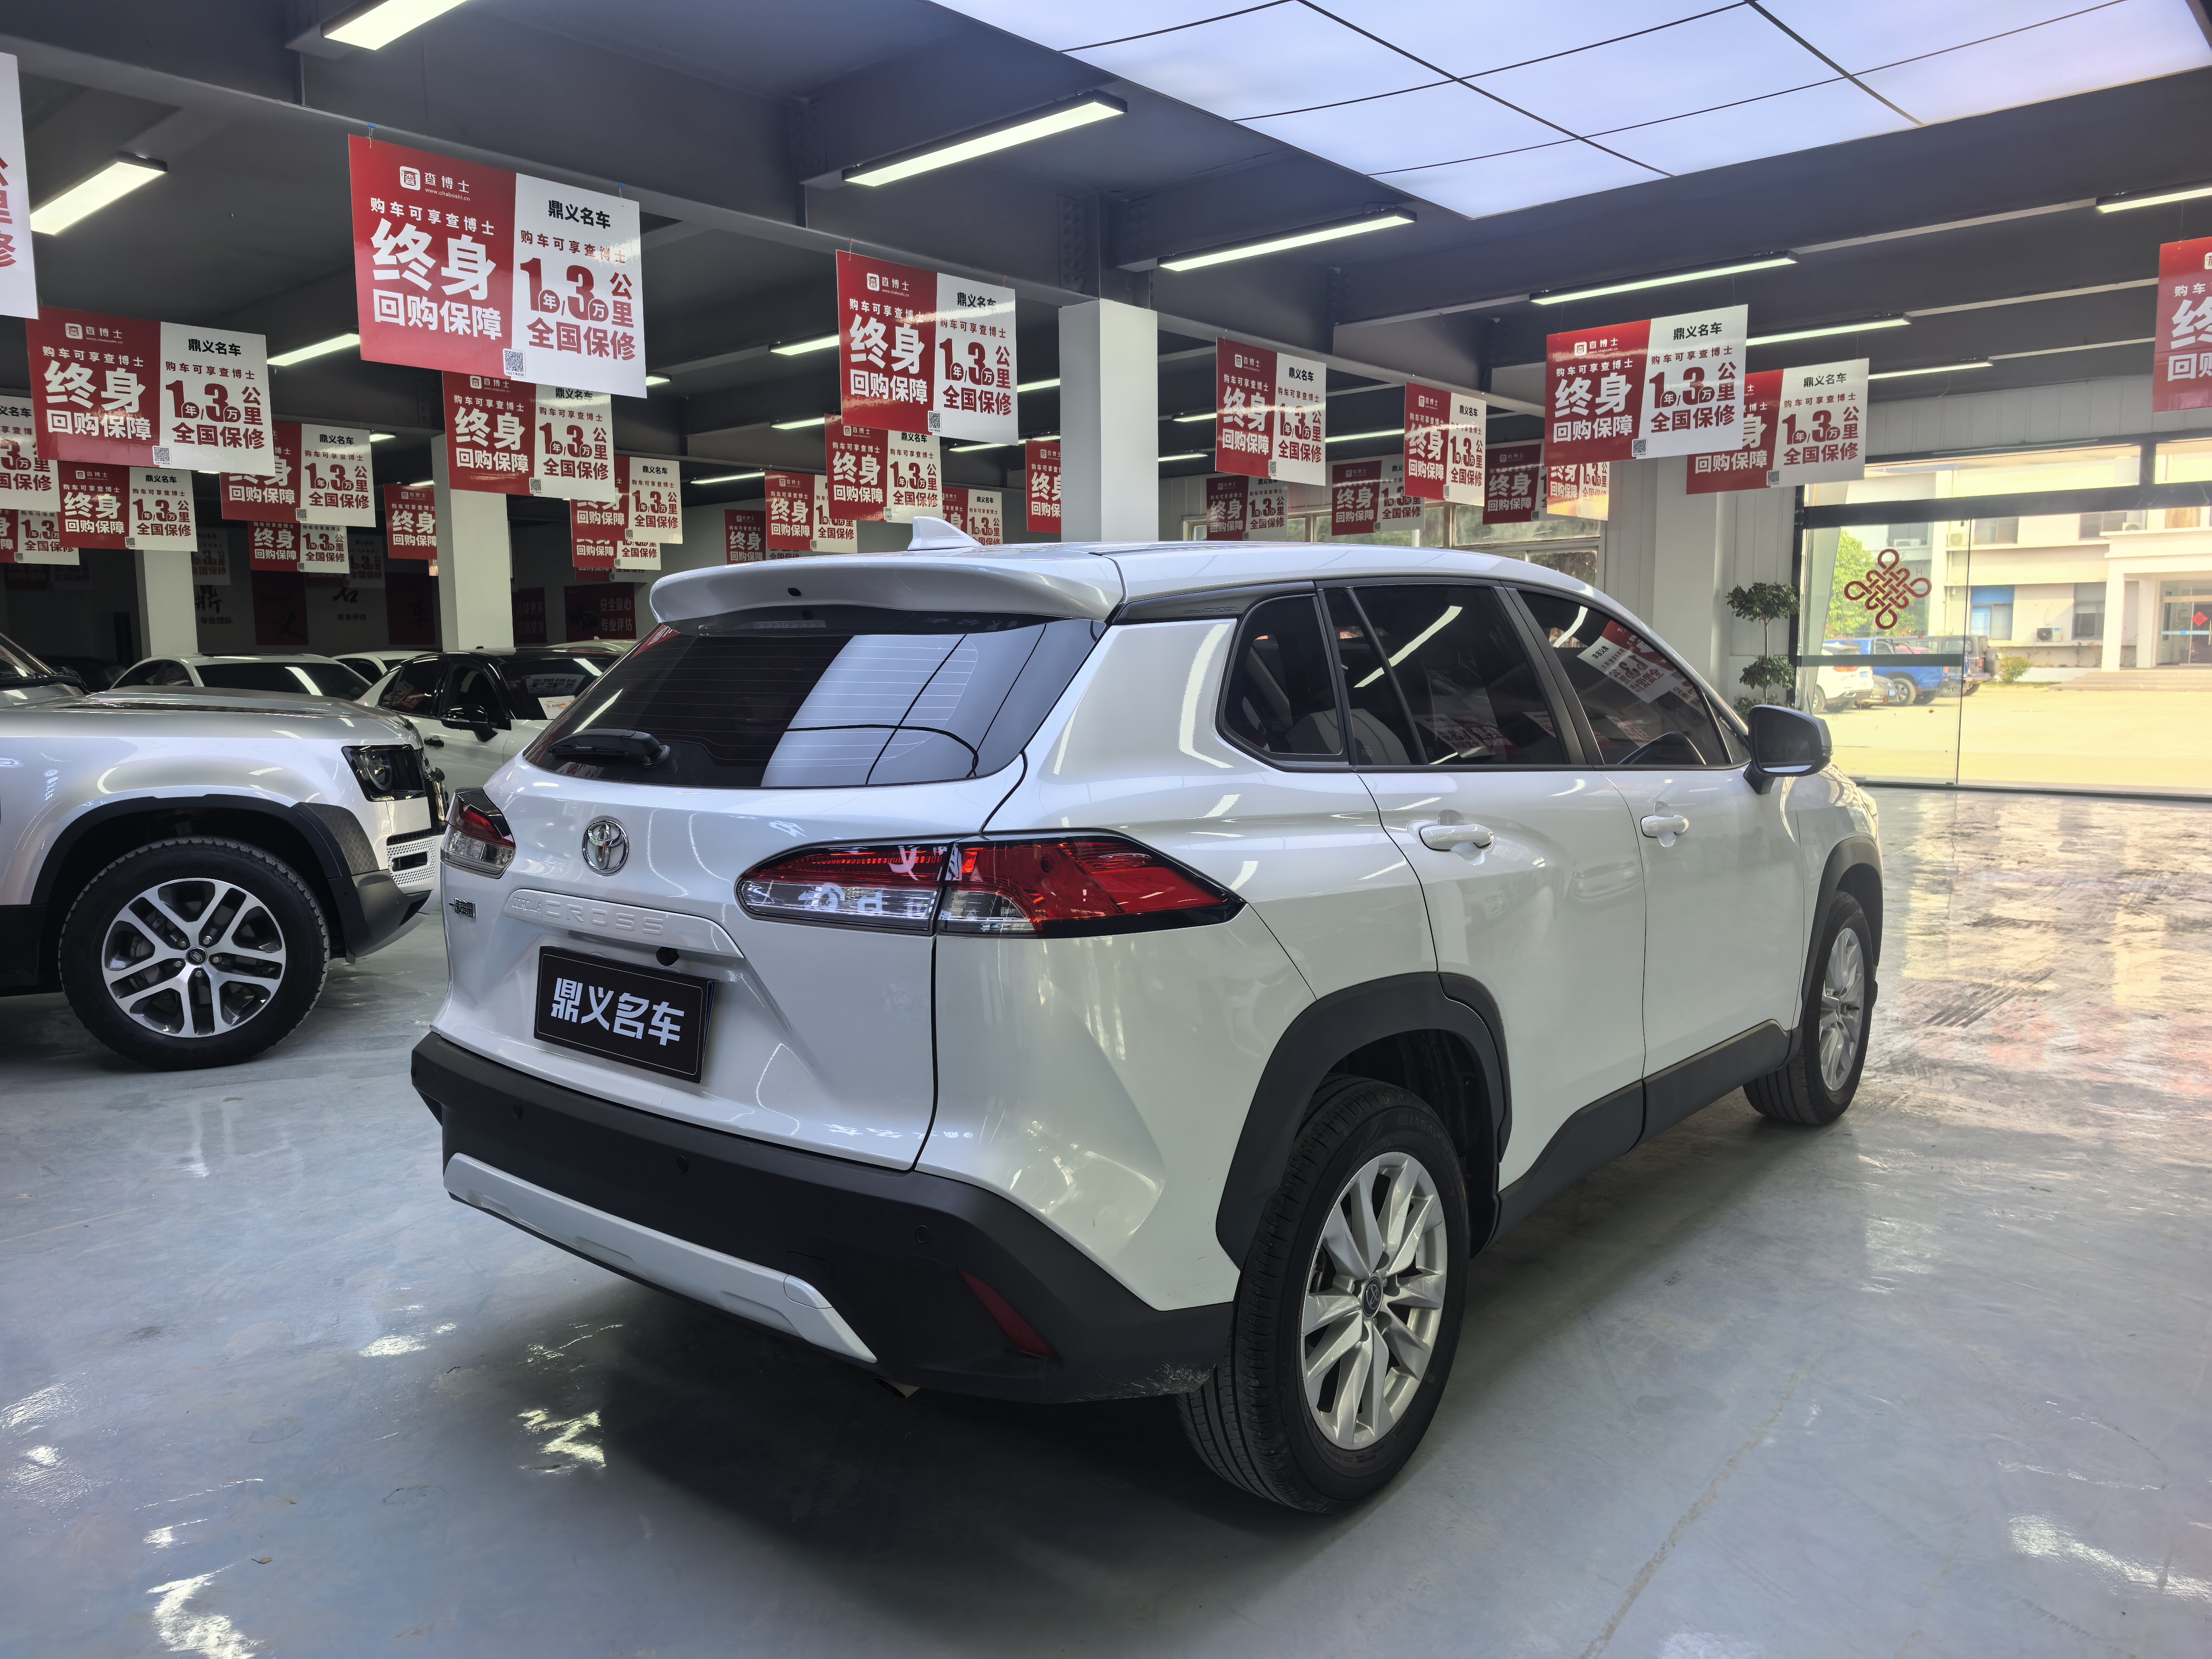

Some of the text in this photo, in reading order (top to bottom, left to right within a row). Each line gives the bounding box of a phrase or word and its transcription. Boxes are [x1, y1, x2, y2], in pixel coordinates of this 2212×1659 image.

[424, 173, 469, 193] 查博士
[425, 188, 470, 201] www.chaboshi.cn
[371, 198, 494, 235] 购车可享查博士
[549, 200, 610, 229] 鼎义名车
[521, 230, 625, 264] 购车可享查博士
[371, 219, 496, 300] 终身
[882, 277, 909, 291] 查博士
[849, 299, 923, 322] 购车可享查博士
[957, 292, 996, 312] 鼎义名车
[373, 289, 502, 340] 回购保障
[940, 317, 1005, 339] 购车可享查博士
[1673, 322, 1722, 340] 鼎义名车
[188, 339, 241, 356] 鼎义名车
[527, 317, 635, 360] 全国保修
[849, 315, 925, 374] 终身
[1590, 338, 1618, 349] 查博士
[43, 347, 143, 367] 购车可享查博士
[1651, 347, 1732, 365] 购车可享查博士
[166, 361, 254, 380] 购车可享查博士
[1289, 367, 1313, 382] 鼎义名车
[1556, 359, 1633, 377] 购车可享查博士
[44, 361, 145, 413] 终身
[850, 369, 927, 404] 回购保障
[1224, 375, 1269, 392] 购车可享查博士
[1804, 373, 1846, 387] 鼎义名车
[454, 395, 524, 412] 购车可享查博士
[556, 387, 593, 402] 鼎义名车
[943, 385, 1011, 416] 全国保修
[1554, 372, 1632, 418] 终身
[1784, 394, 1855, 408] 购车可享查博士
[0, 407, 32, 417] 义名车
[539, 407, 602, 422] 购车可享查博士
[1223, 387, 1269, 431] 终身
[1650, 404, 1735, 433] 全国保修
[46, 410, 152, 440] 回购保障
[454, 407, 525, 450] 终身
[1553, 414, 1633, 443] 回购保障
[172, 422, 264, 449] 全国保修
[320, 434, 354, 445] 鼎义名车
[901, 432, 927, 443] 鼎义名车
[1223, 428, 1269, 455] 回购保障
[1409, 423, 1444, 461] 终身
[833, 442, 880, 453] 购车可享查博士
[891, 448, 933, 459] 购车可享查博士
[1278, 439, 1321, 463] 全国保修
[1783, 442, 1858, 466] 全国保修
[456, 448, 529, 473] 回购保障
[543, 457, 608, 480] 全国保修
[833, 451, 881, 485] 终身
[1408, 459, 1444, 481] 回购保障
[1695, 450, 1768, 474] 回购保障
[146, 475, 177, 483] 鼎义名车
[643, 466, 668, 475] 鼎义名车
[1451, 467, 1482, 487] 全国保修
[0, 472, 52, 491] 国保修
[1488, 473, 1532, 497] 终身
[229, 485, 295, 504] 回购保障
[308, 491, 369, 509] 全国保修
[834, 485, 883, 503] 回购保障
[893, 490, 938, 508] 全国保修
[1336, 487, 1374, 510] 终身
[64, 492, 121, 519] 终身
[771, 498, 808, 523] 终身
[1031, 501, 1061, 517] 回购保
[1210, 499, 1243, 521] 终身
[1382, 506, 1421, 520] 全国保修
[1488, 497, 1532, 512] 回购保障
[392, 510, 436, 534] 终身
[577, 510, 625, 525] 回购保障
[634, 514, 678, 528] 全国保修
[1250, 517, 1284, 530] 全国保修
[1336, 509, 1374, 523] 回购保障
[65, 519, 125, 534] 回购保障
[136, 522, 191, 536] 全国保修
[771, 523, 810, 537] 回购保障
[818, 527, 854, 539] 全国保修
[1210, 520, 1243, 533] 回购保障
[253, 528, 295, 549] 终身
[730, 531, 761, 550] 终身
[254, 549, 297, 560] 回购保障
[305, 551, 345, 562] 全国保修
[576, 545, 614, 556] 回购保障
[622, 547, 657, 558] 全国保修
[730, 551, 763, 562] 回购保障
[601, 597, 631, 612] 安全放心
[601, 617, 632, 632] 专业评估
[545, 900, 664, 936] CROSS
[551, 977, 685, 1046] 鼎义名车
